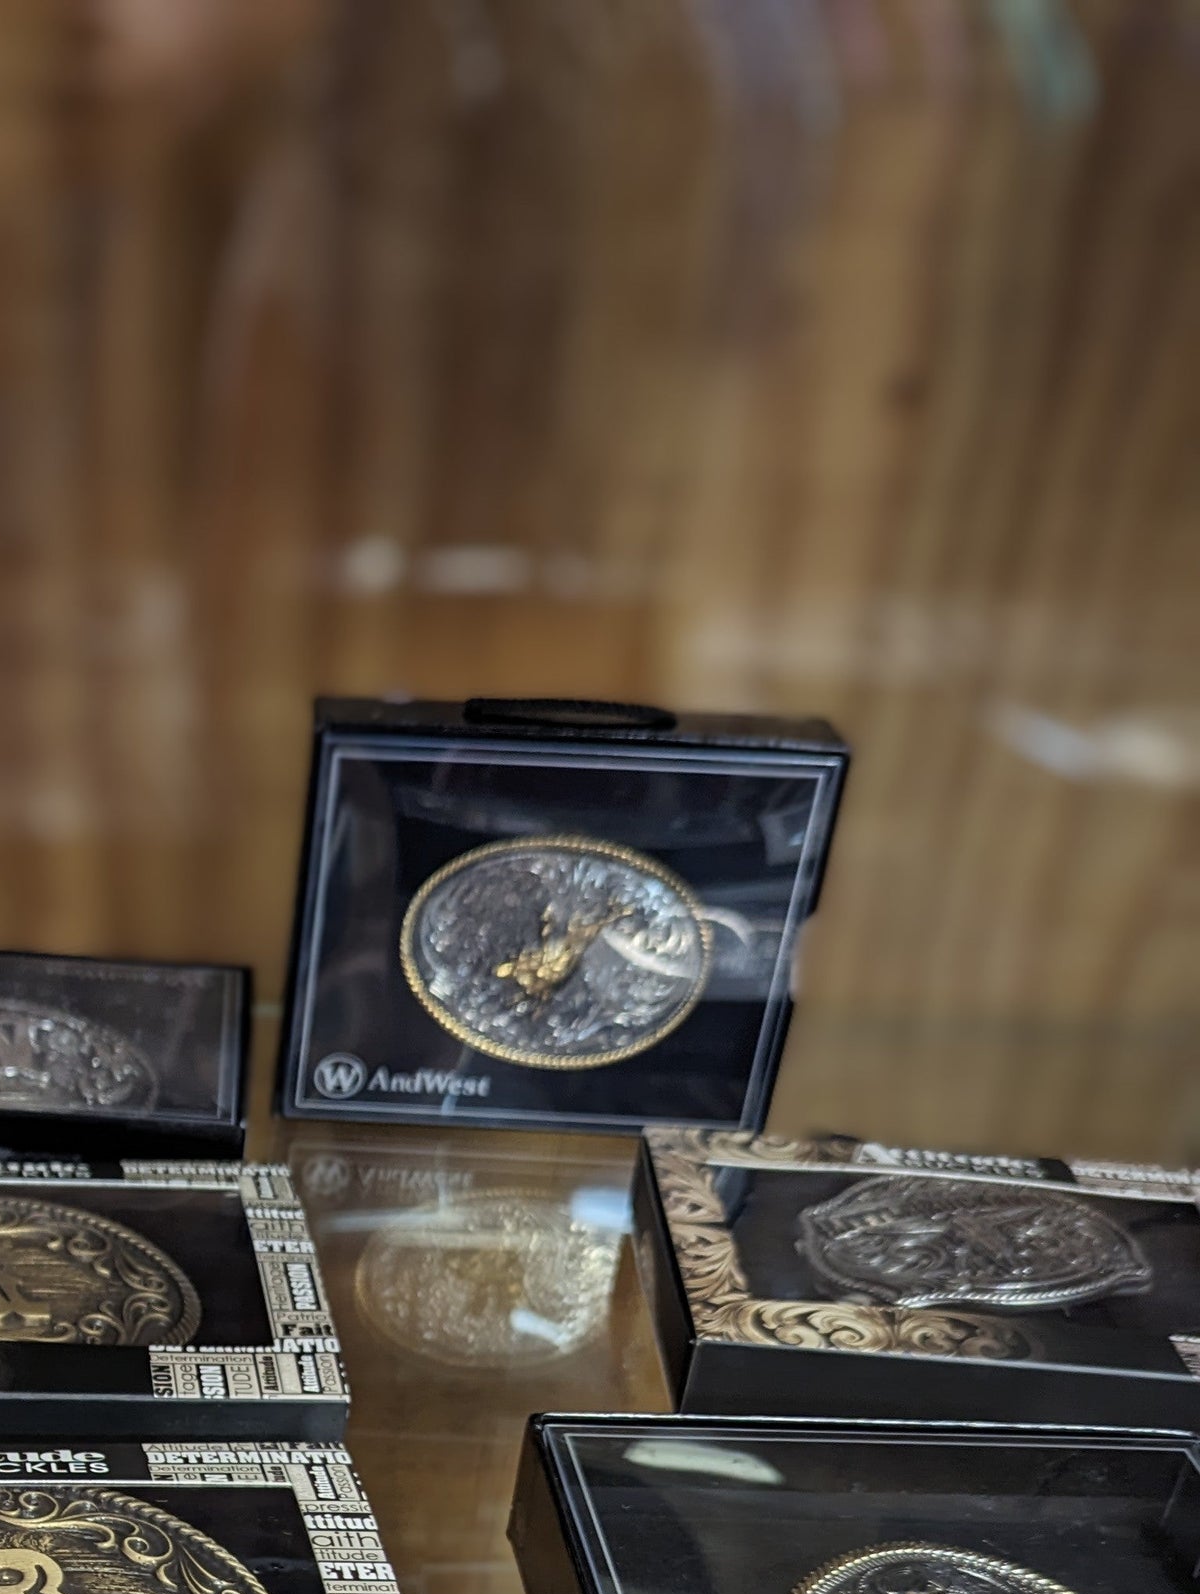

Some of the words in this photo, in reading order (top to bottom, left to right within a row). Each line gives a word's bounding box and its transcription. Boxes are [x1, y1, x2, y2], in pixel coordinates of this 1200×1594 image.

[367, 1066, 491, 1097] AndWest
[286, 1263, 317, 1310] PASSION
[147, 1451, 353, 1464] DETERMINATIO
[150, 1465, 261, 1473] Determination
[301, 1503, 370, 1514] pressi
[319, 1562, 397, 1580] ETER
